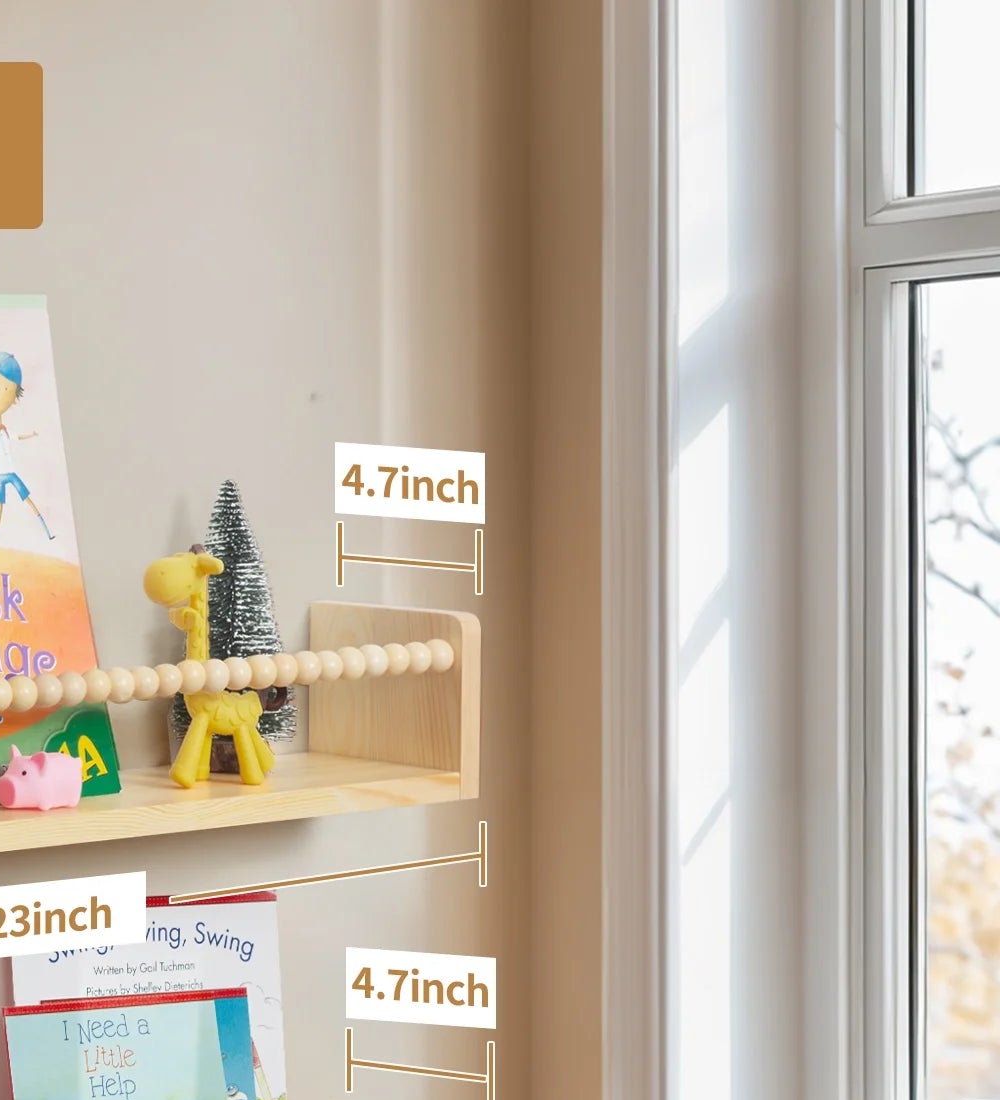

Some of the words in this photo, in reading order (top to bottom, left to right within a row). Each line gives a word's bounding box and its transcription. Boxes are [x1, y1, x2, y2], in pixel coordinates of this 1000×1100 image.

[194, 921, 255, 962] Swing
[93, 965, 124, 975] Written
[126, 963, 137, 976] by
[140, 961, 158, 973] Gail
[160, 960, 196, 972] Tuchman
[86, 986, 117, 996] Pictures
[62, 1020, 69, 1041] I
[77, 1013, 130, 1044] Need
[137, 1018, 150, 1035] a
[83, 1044, 136, 1073] Little
